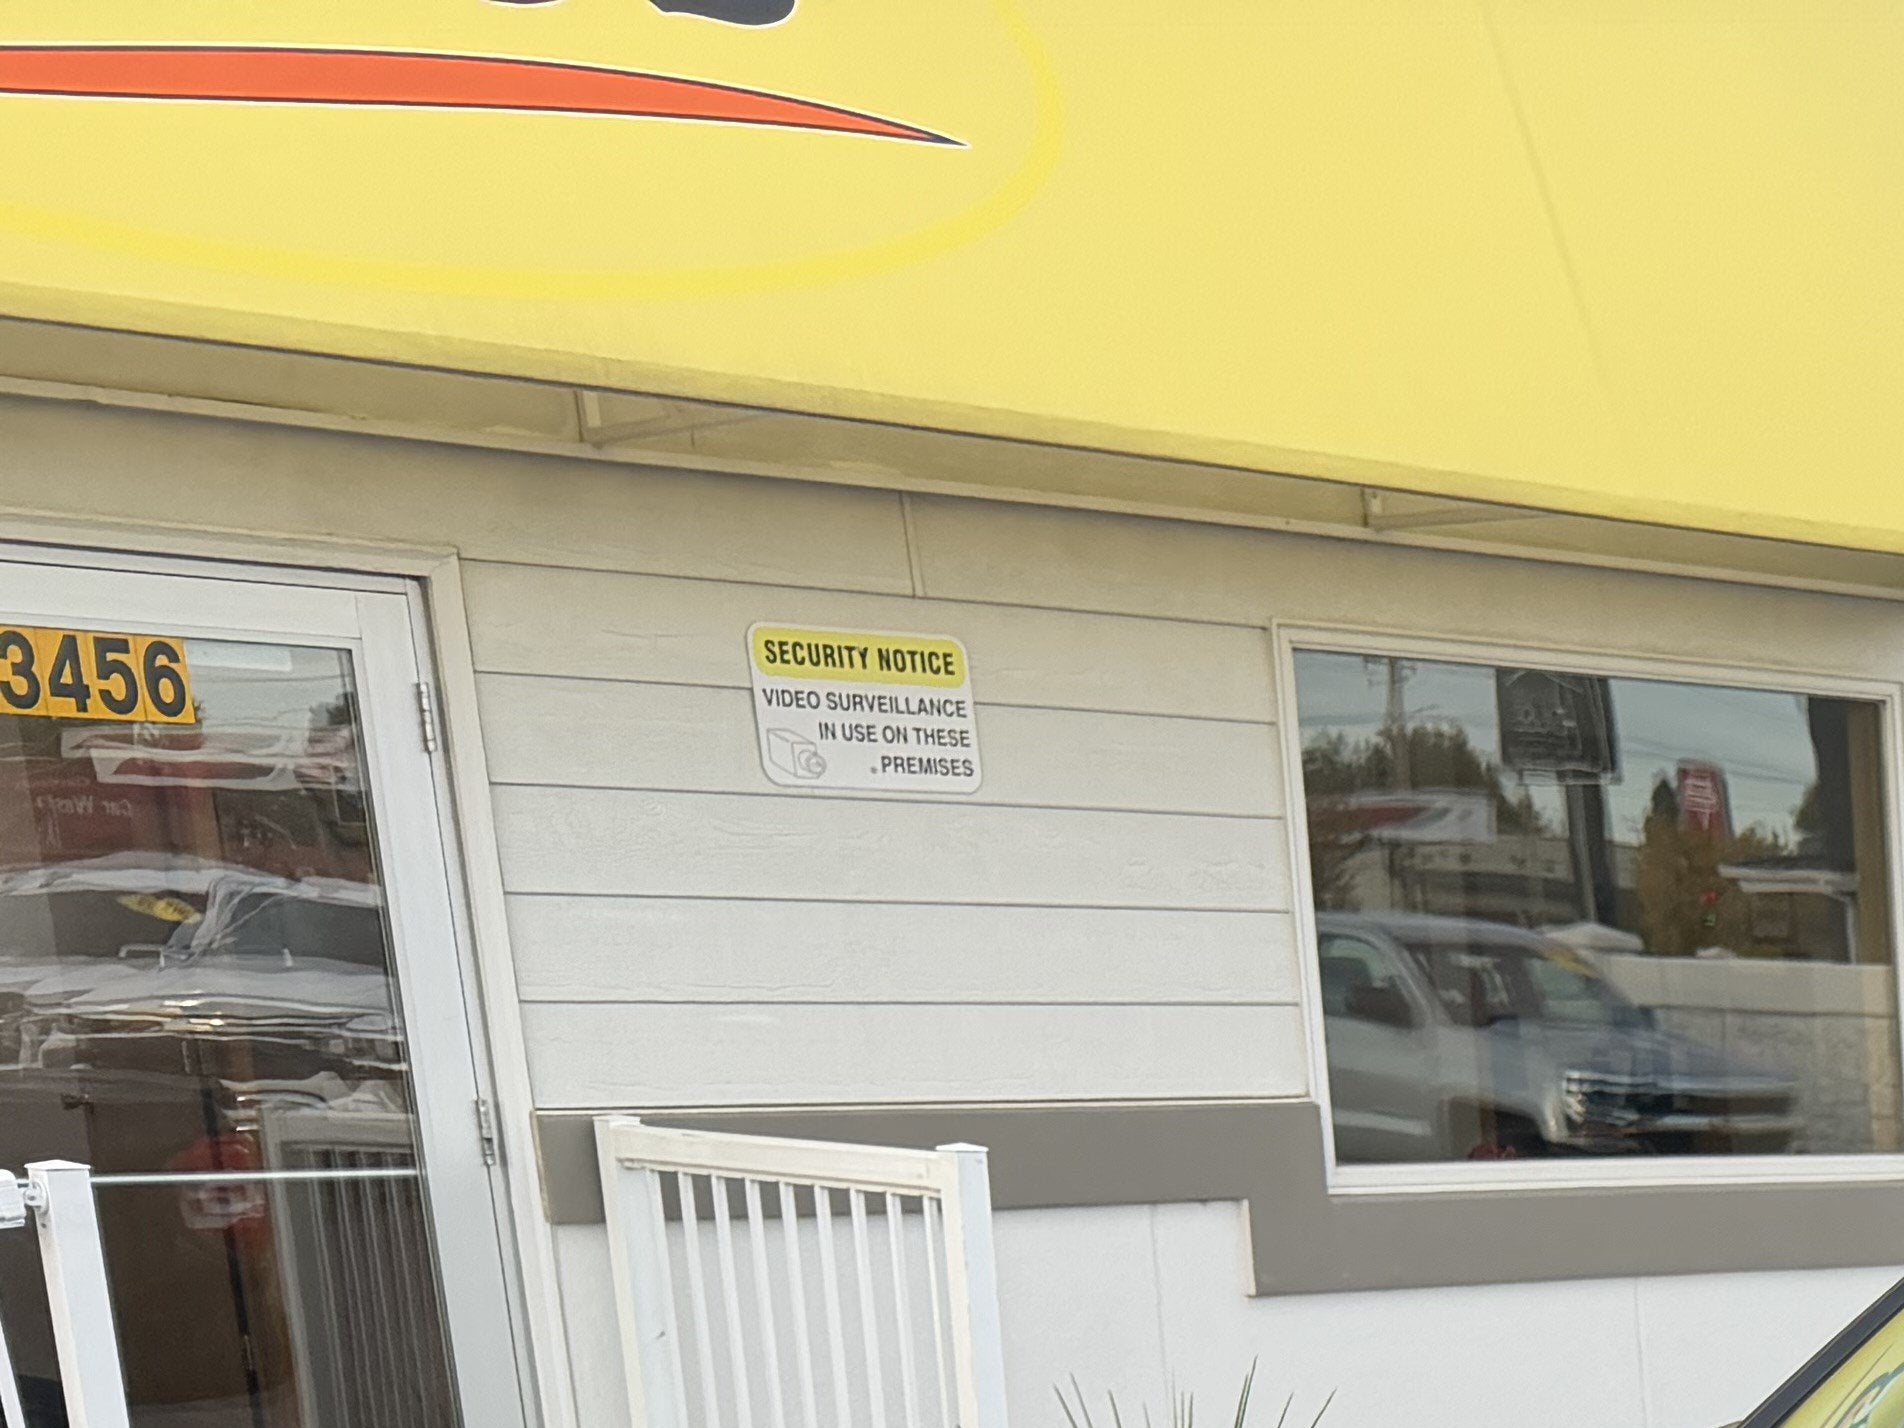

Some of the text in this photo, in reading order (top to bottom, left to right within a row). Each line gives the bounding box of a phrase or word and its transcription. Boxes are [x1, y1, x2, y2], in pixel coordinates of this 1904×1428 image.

[764, 639, 956, 676] SECURITY NOTICE
[0, 630, 188, 718] 3456
[762, 688, 968, 718] VIDEO SURVEILLANCE
[818, 722, 971, 748] IN USE ON THESE
[881, 755, 975, 777] PREMISES
